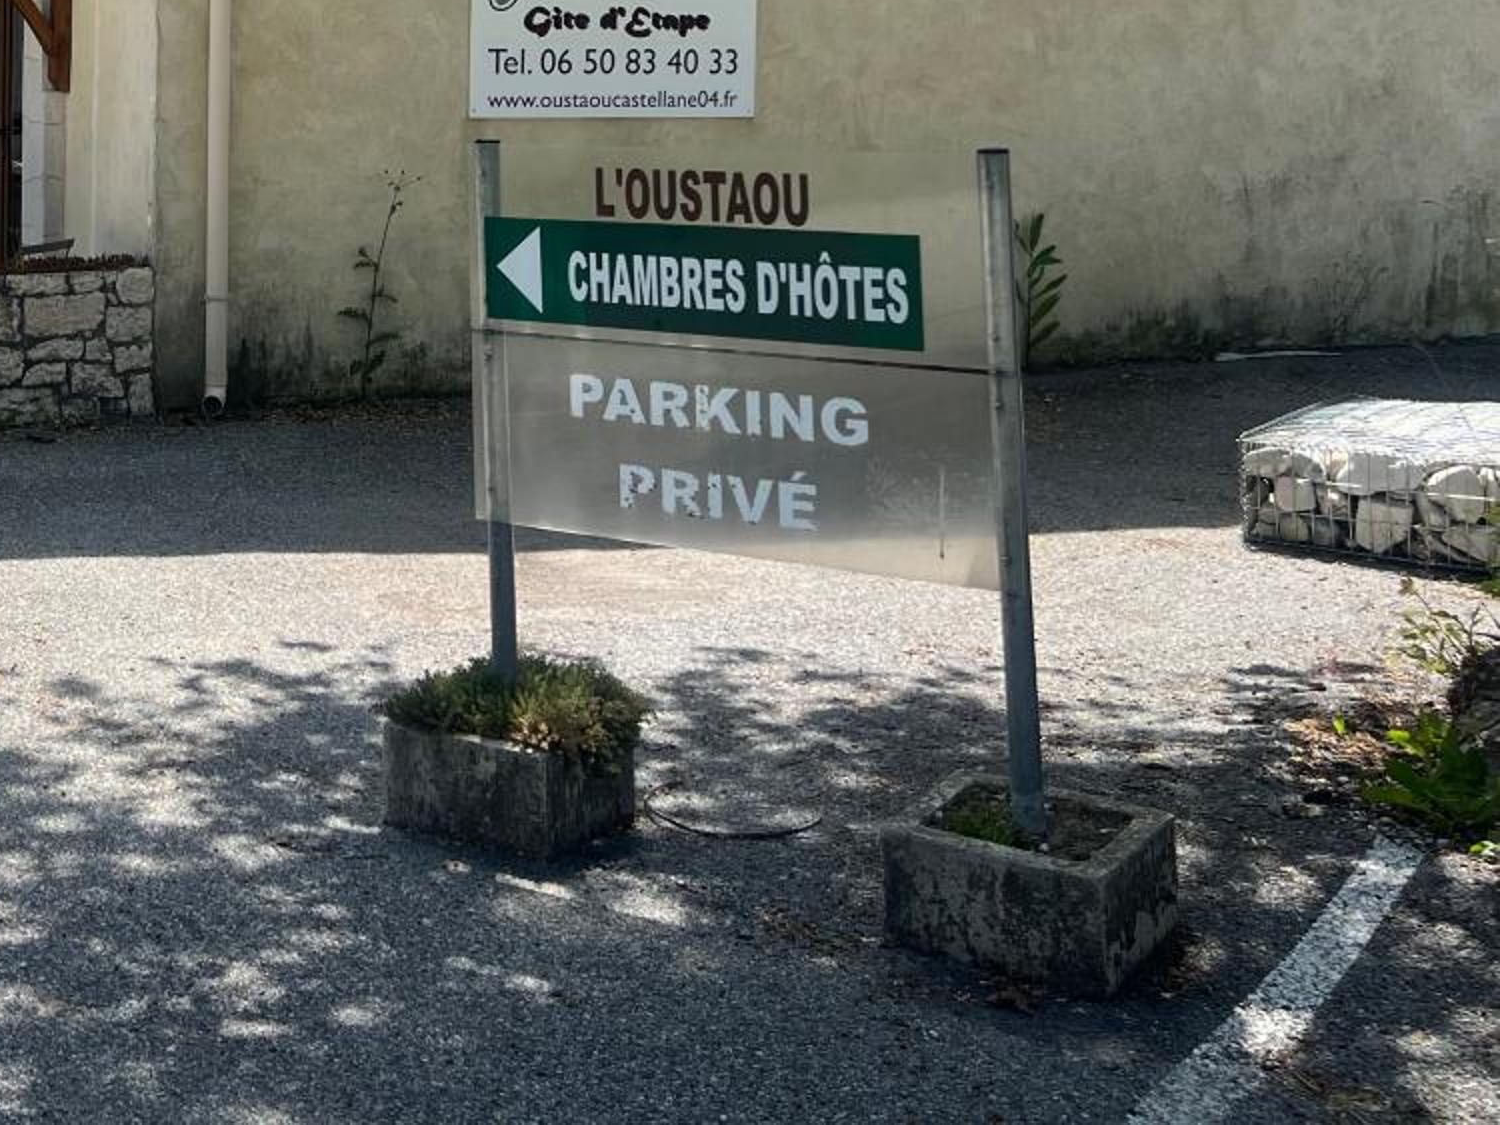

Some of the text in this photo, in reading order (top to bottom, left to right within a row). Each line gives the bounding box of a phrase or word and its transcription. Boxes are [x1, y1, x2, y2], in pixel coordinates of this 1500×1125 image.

[599, 6, 711, 38] d'Etape
[487, 48, 739, 76] Tel. 06 50 83 40 33
[487, 90, 739, 109] www.oustaoucastellane04.fr
[595, 167, 810, 227] L'OUSTAOU
[567, 250, 910, 325] CHAMBRES D'HÔTES
[568, 373, 870, 447] PARKING
[618, 463, 821, 532] PRIVÉ
